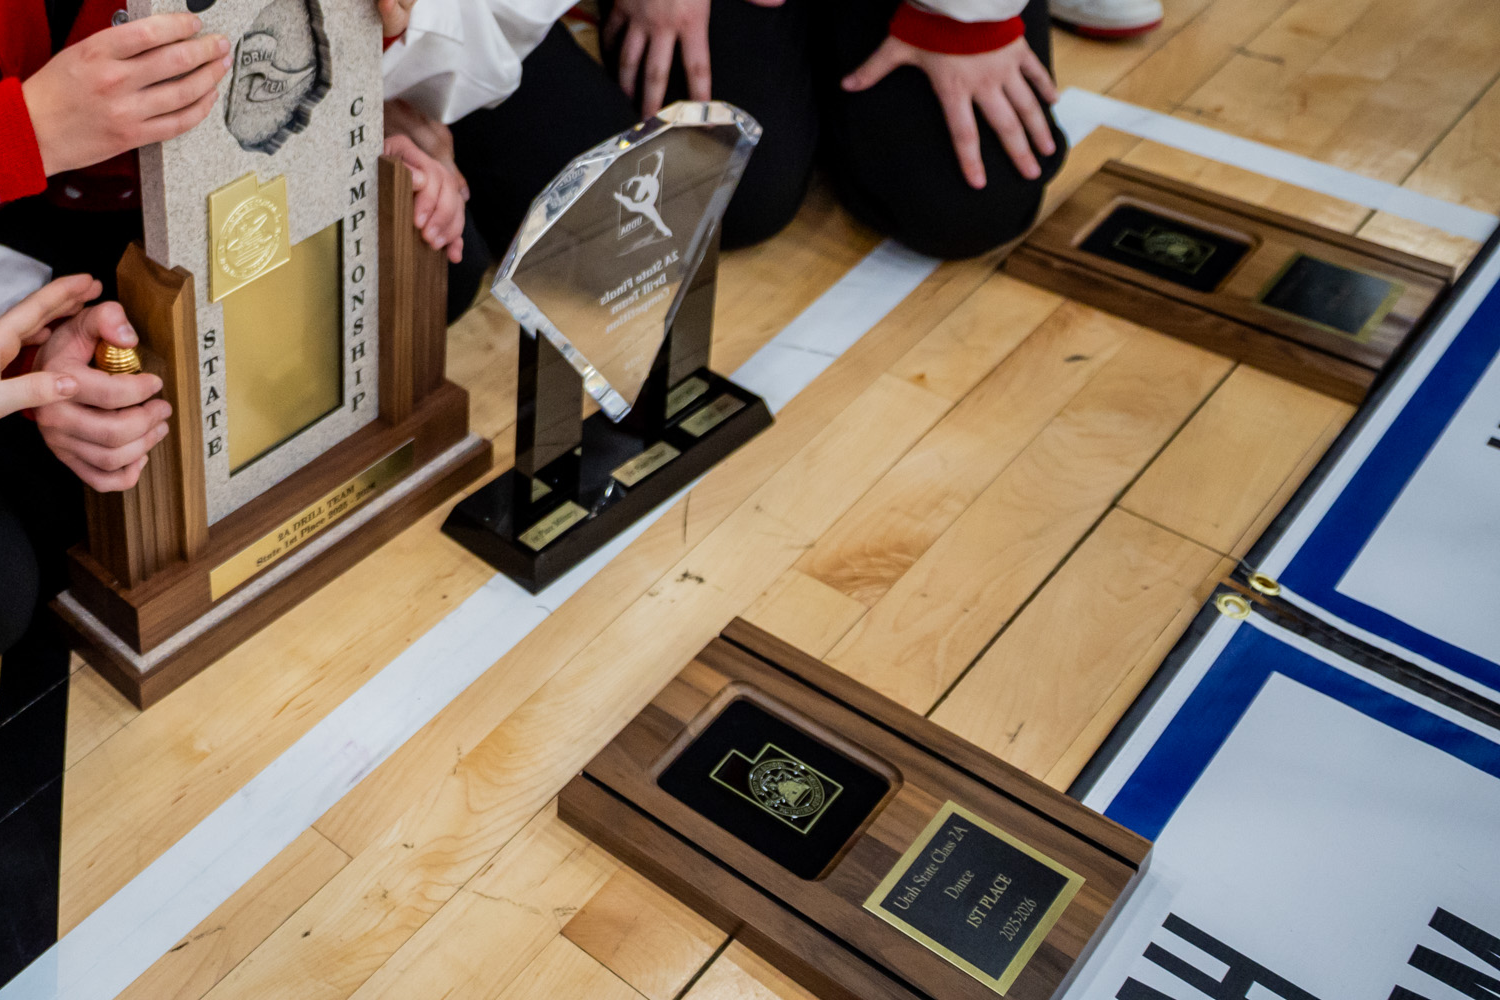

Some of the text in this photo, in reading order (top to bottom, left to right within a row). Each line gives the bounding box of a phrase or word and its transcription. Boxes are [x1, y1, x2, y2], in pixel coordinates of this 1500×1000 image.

[349, 96, 366, 413] CHAMPIONSHIP
[203, 328, 223, 459] STATE
[292, 507, 326, 532] DRILL
[326, 484, 355, 508] TEAM
[300, 517, 326, 538] Place
[893, 825, 969, 911] Utah State Class 2A
[943, 869, 976, 900] Dance
[966, 873, 1013, 929] 1ST PLACE
[999, 897, 1038, 942] 2025-2026
